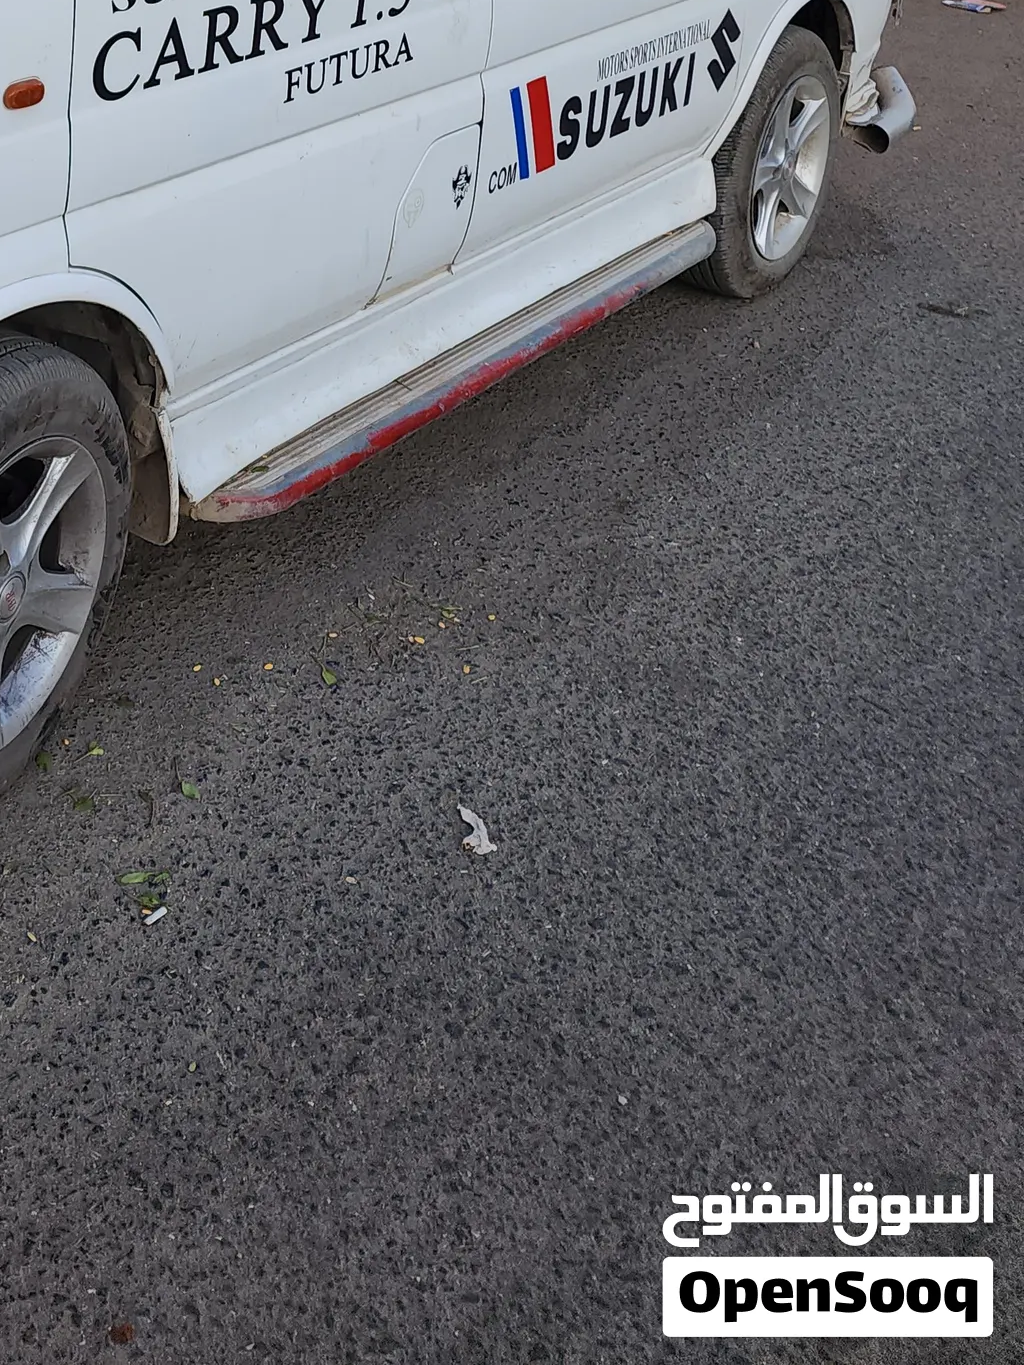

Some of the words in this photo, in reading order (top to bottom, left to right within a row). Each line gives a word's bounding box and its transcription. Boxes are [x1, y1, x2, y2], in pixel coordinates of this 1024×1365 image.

[283, 32, 414, 104] FUTURA
[596, 47, 629, 82] MOTORS
[629, 38, 656, 69] SPORTS
[656, 19, 711, 58] INTERNATIONAL
[556, 51, 696, 161] SUZUKI
[488, 161, 517, 194] COM
